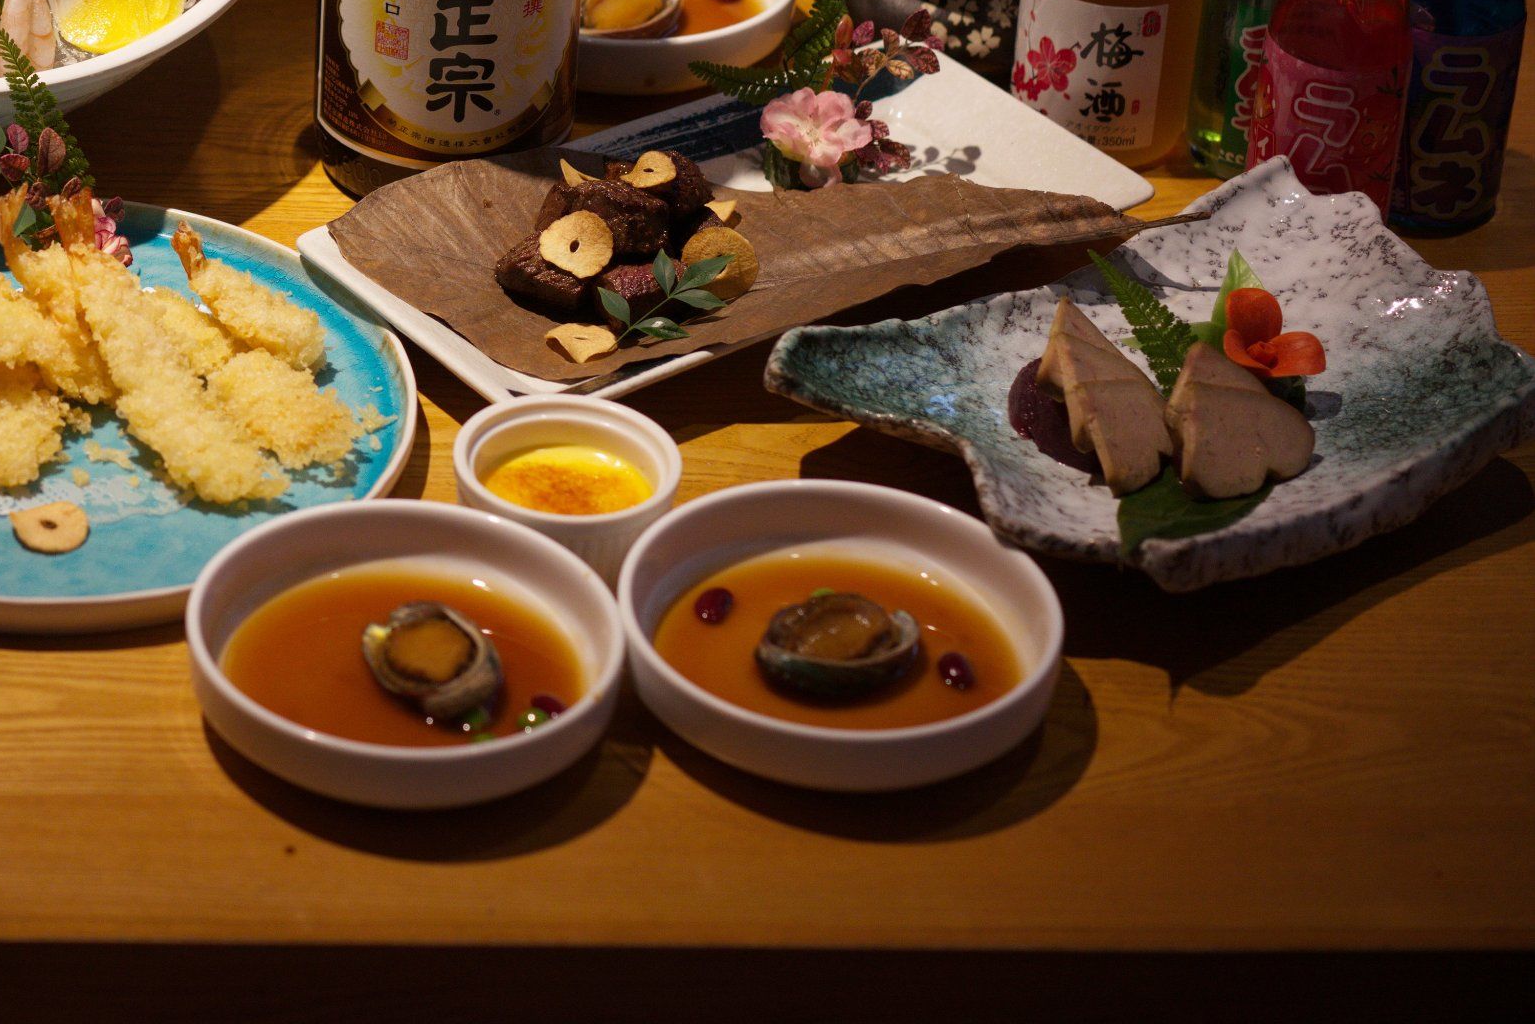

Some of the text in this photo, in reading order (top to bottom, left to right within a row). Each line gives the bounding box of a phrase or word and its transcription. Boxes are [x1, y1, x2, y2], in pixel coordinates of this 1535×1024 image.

[1079, 23, 1143, 122] 梅酒
[1287, 81, 1360, 195] ラム
[1409, 46, 1497, 220] ラムネ
